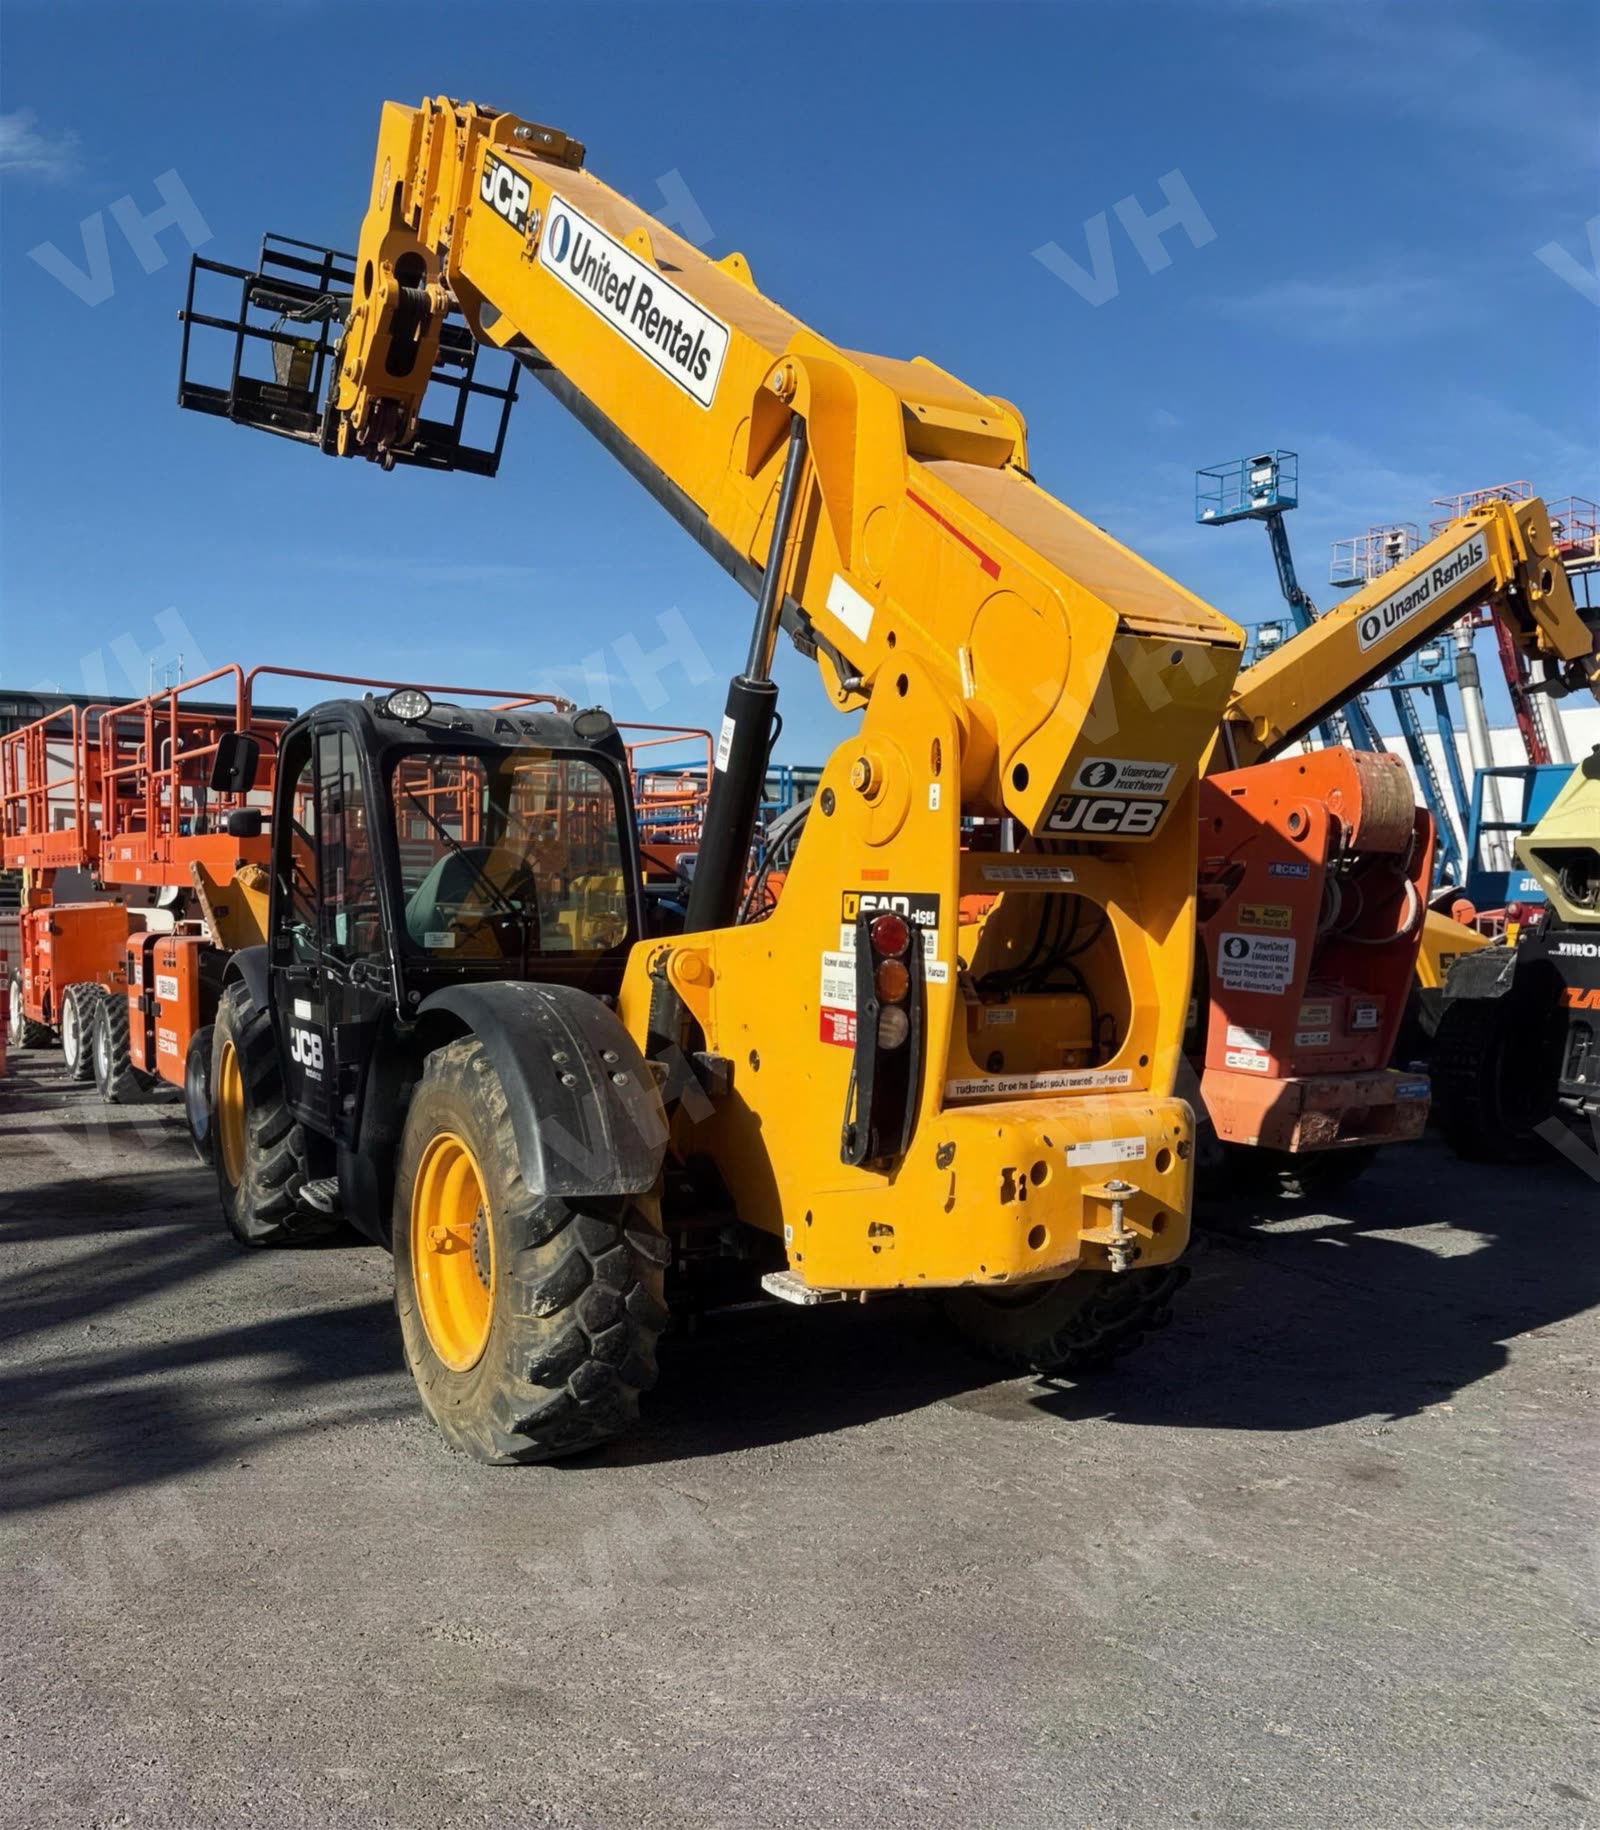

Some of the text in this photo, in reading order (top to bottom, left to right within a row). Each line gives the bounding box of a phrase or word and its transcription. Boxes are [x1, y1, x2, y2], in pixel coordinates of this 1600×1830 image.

[570, 231, 711, 382] United Rentals
[1049, 799, 1164, 833] JCB
[291, 1027, 324, 1070] JCB
